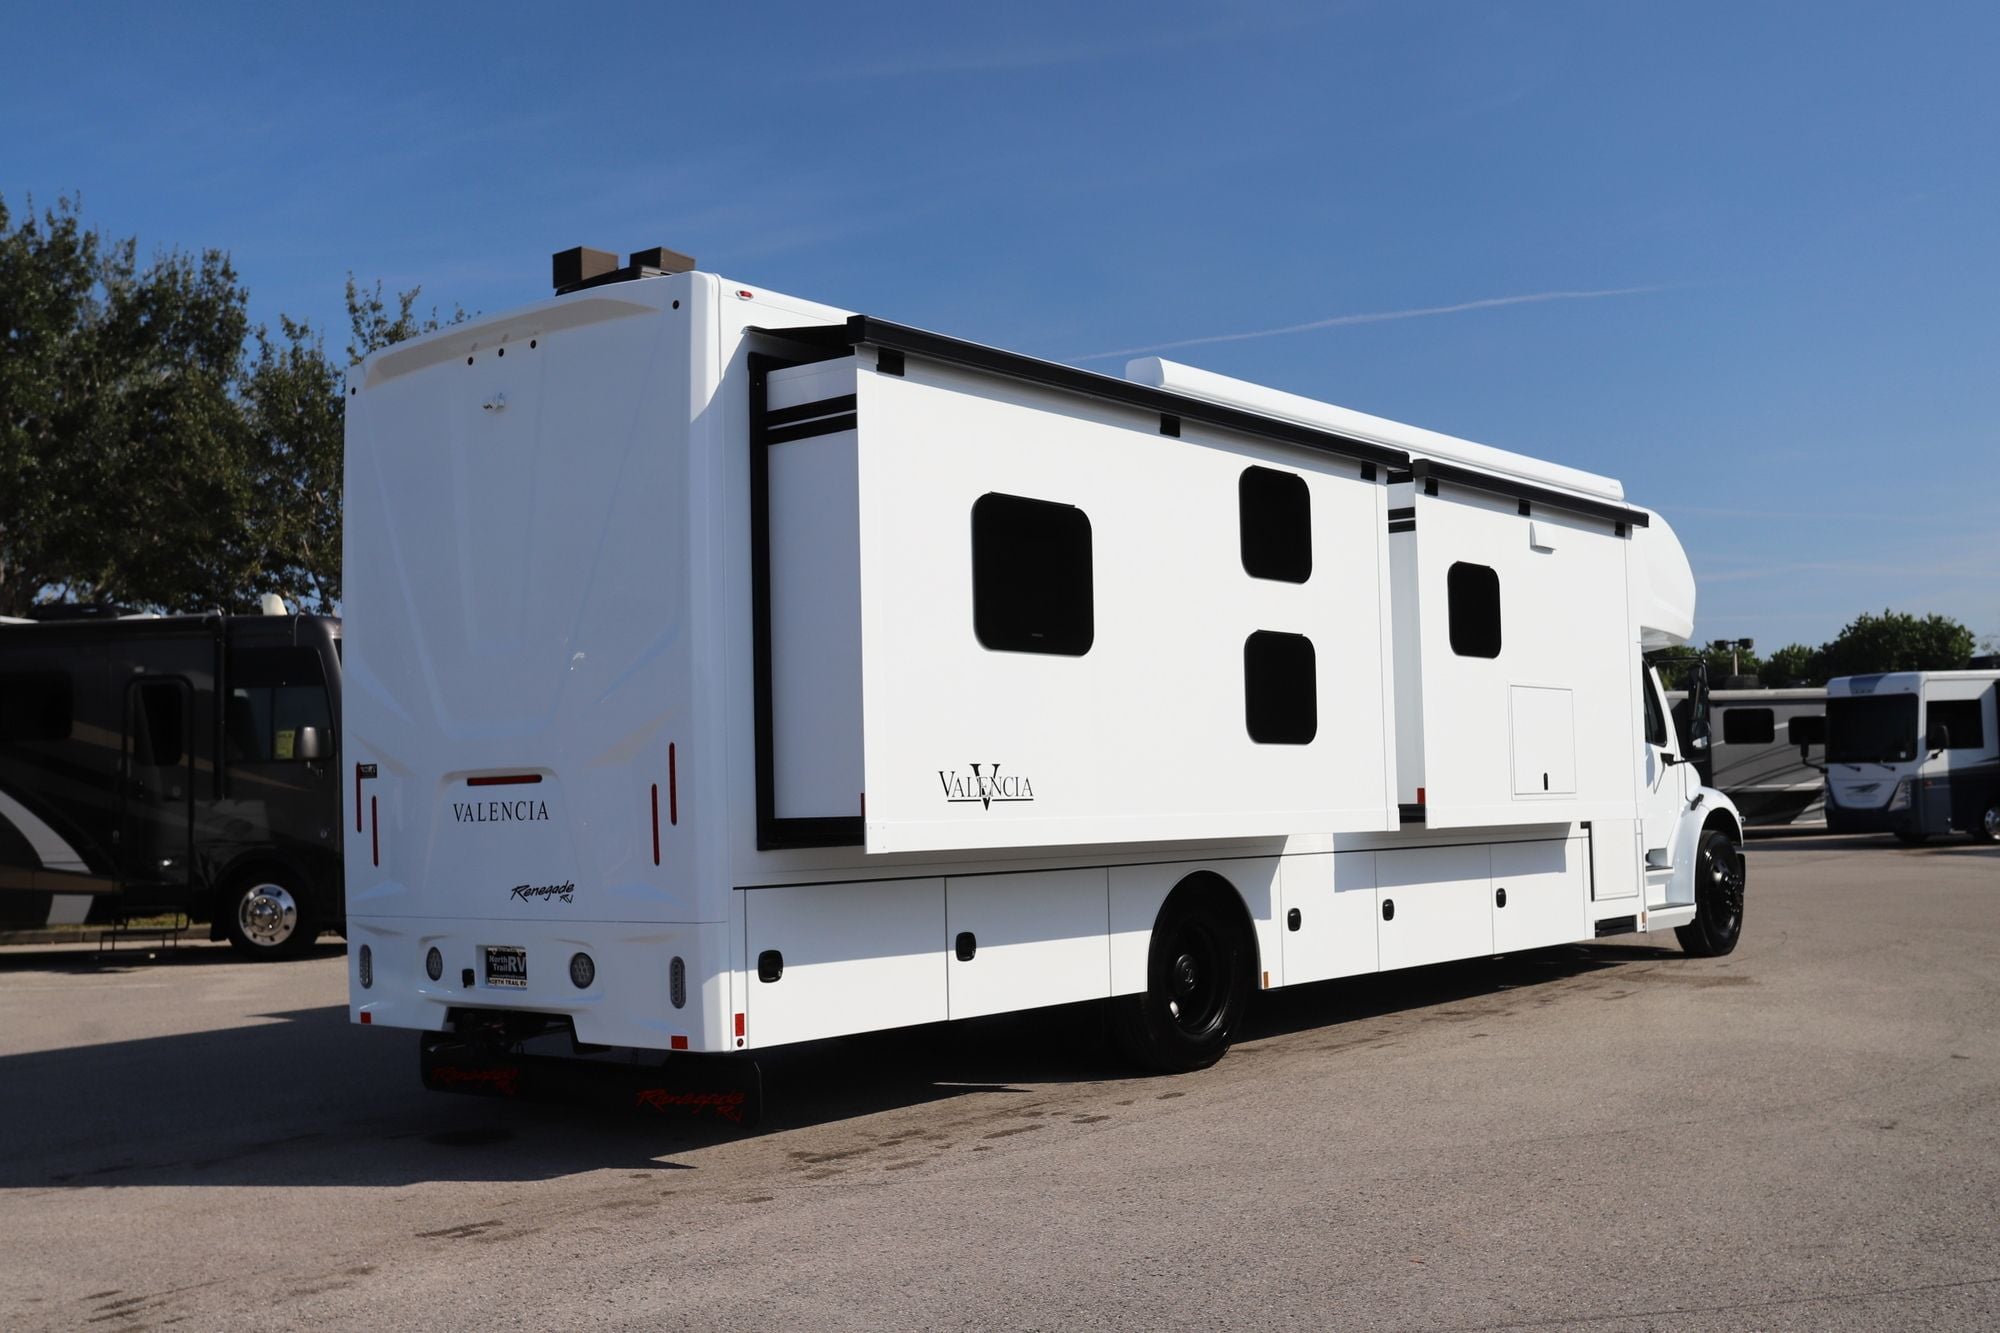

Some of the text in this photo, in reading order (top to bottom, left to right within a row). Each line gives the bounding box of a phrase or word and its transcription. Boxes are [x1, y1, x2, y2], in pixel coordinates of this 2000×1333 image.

[453, 800, 549, 823] VALENCIA
[510, 880, 575, 903] Renegade
[559, 894, 574, 904] RV
[489, 955, 508, 964] North
[507, 956, 527, 973] RV
[492, 963, 508, 972] Trail
